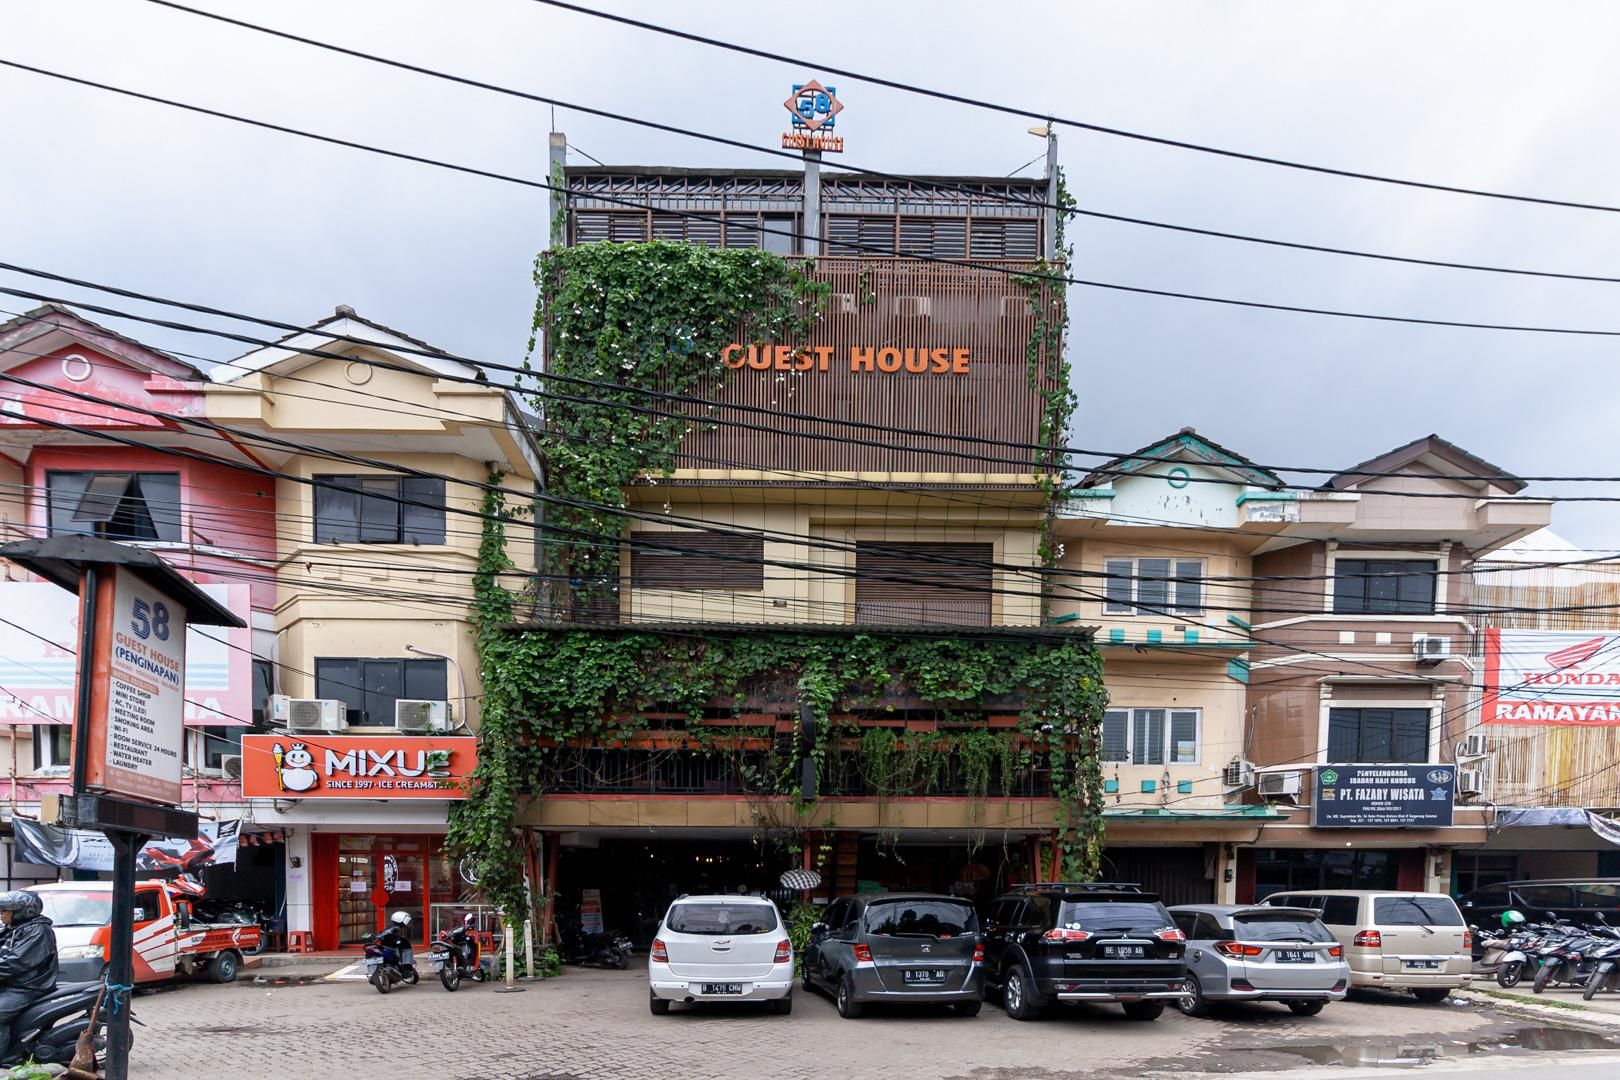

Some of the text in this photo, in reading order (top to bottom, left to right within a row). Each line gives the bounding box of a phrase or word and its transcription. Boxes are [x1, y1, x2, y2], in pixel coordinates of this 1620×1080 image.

[799, 93, 829, 119] 58
[851, 346, 969, 373] HOUSE
[130, 596, 170, 641] 58
[116, 632, 148, 655] GUEST
[150, 649, 179, 672] HOUSE
[115, 646, 179, 686] (PENGINAPAN)
[1523, 672, 1620, 685] HONDA
[115, 690, 146, 706] MINI STORE
[116, 681, 151, 699] COFFEE SHOP
[115, 707, 155, 726] MEETING ROOM
[115, 716, 153, 734] SMOKING AREA
[113, 742, 148, 757] RESTAURANT
[114, 733, 130, 743] ROOM
[132, 739, 152, 750] SERVICE
[161, 747, 177, 757] HOURS
[113, 750, 152, 766] WATER HEATER
[113, 759, 138, 770] LAUNDRY
[325, 749, 450, 777] MIXUE
[326, 780, 353, 789] SINCE
[355, 780, 372, 789] 1997
[378, 780, 392, 789] ICE
[1340, 788, 1424, 800] PT. FAZARY WISATA
